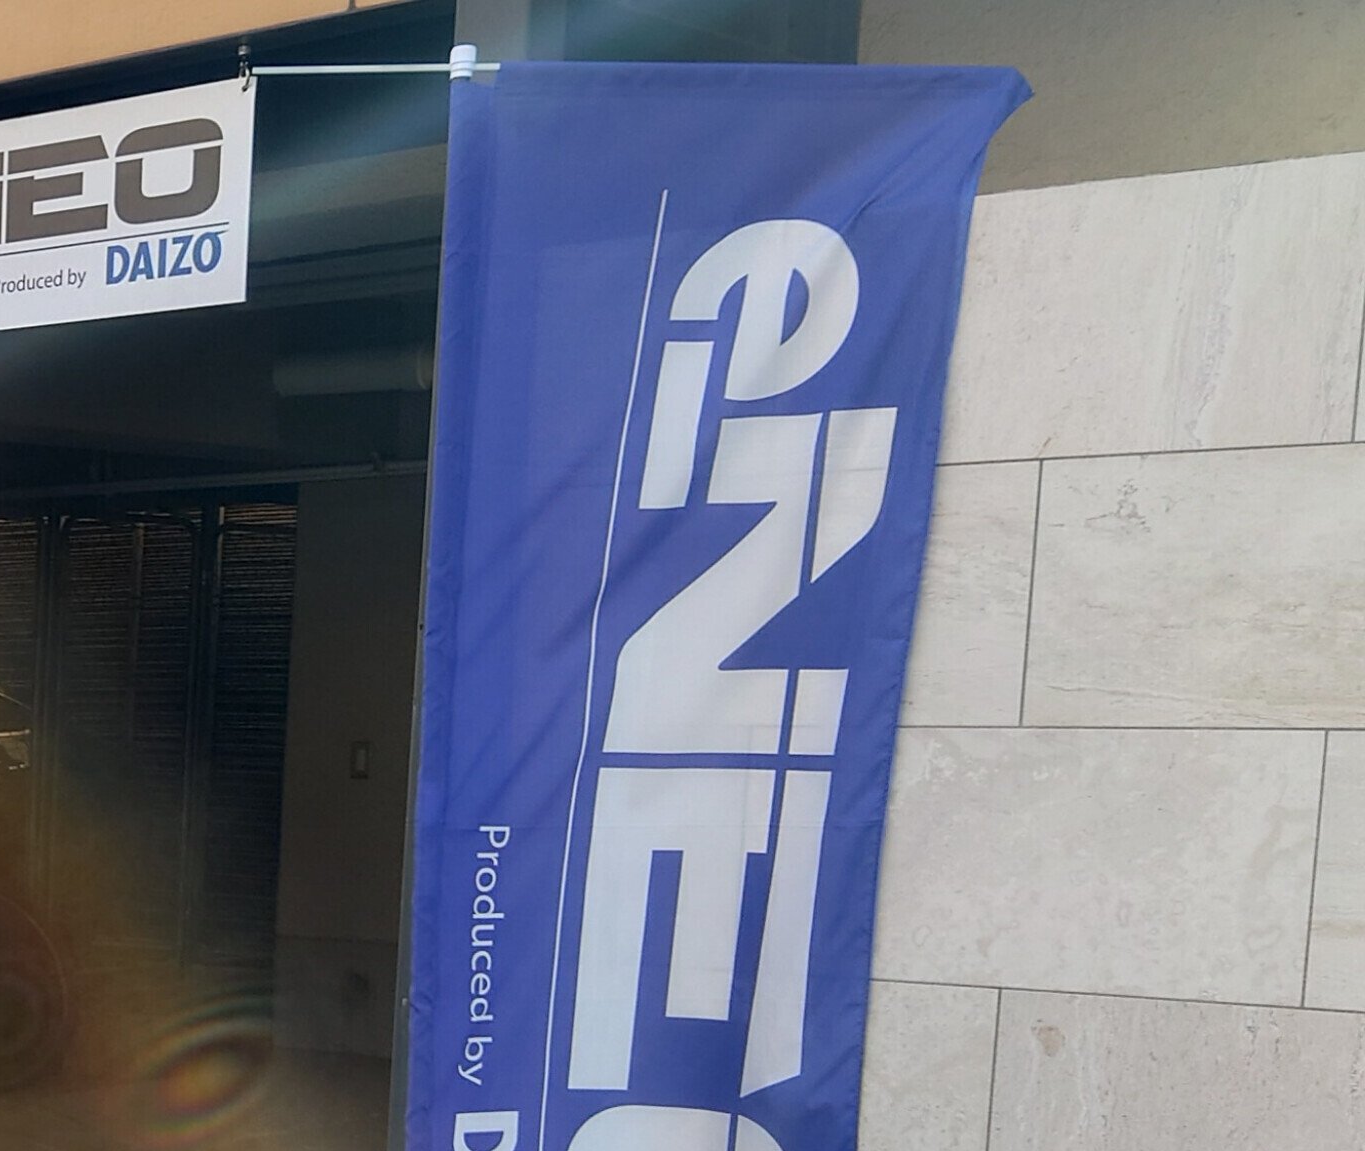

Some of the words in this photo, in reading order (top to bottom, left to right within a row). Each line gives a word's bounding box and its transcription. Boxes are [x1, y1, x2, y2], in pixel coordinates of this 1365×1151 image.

[67, 268, 88, 289] by
[106, 228, 228, 286] DAIZO
[469, 823, 511, 1024] Produced
[458, 1035, 494, 1087] by
